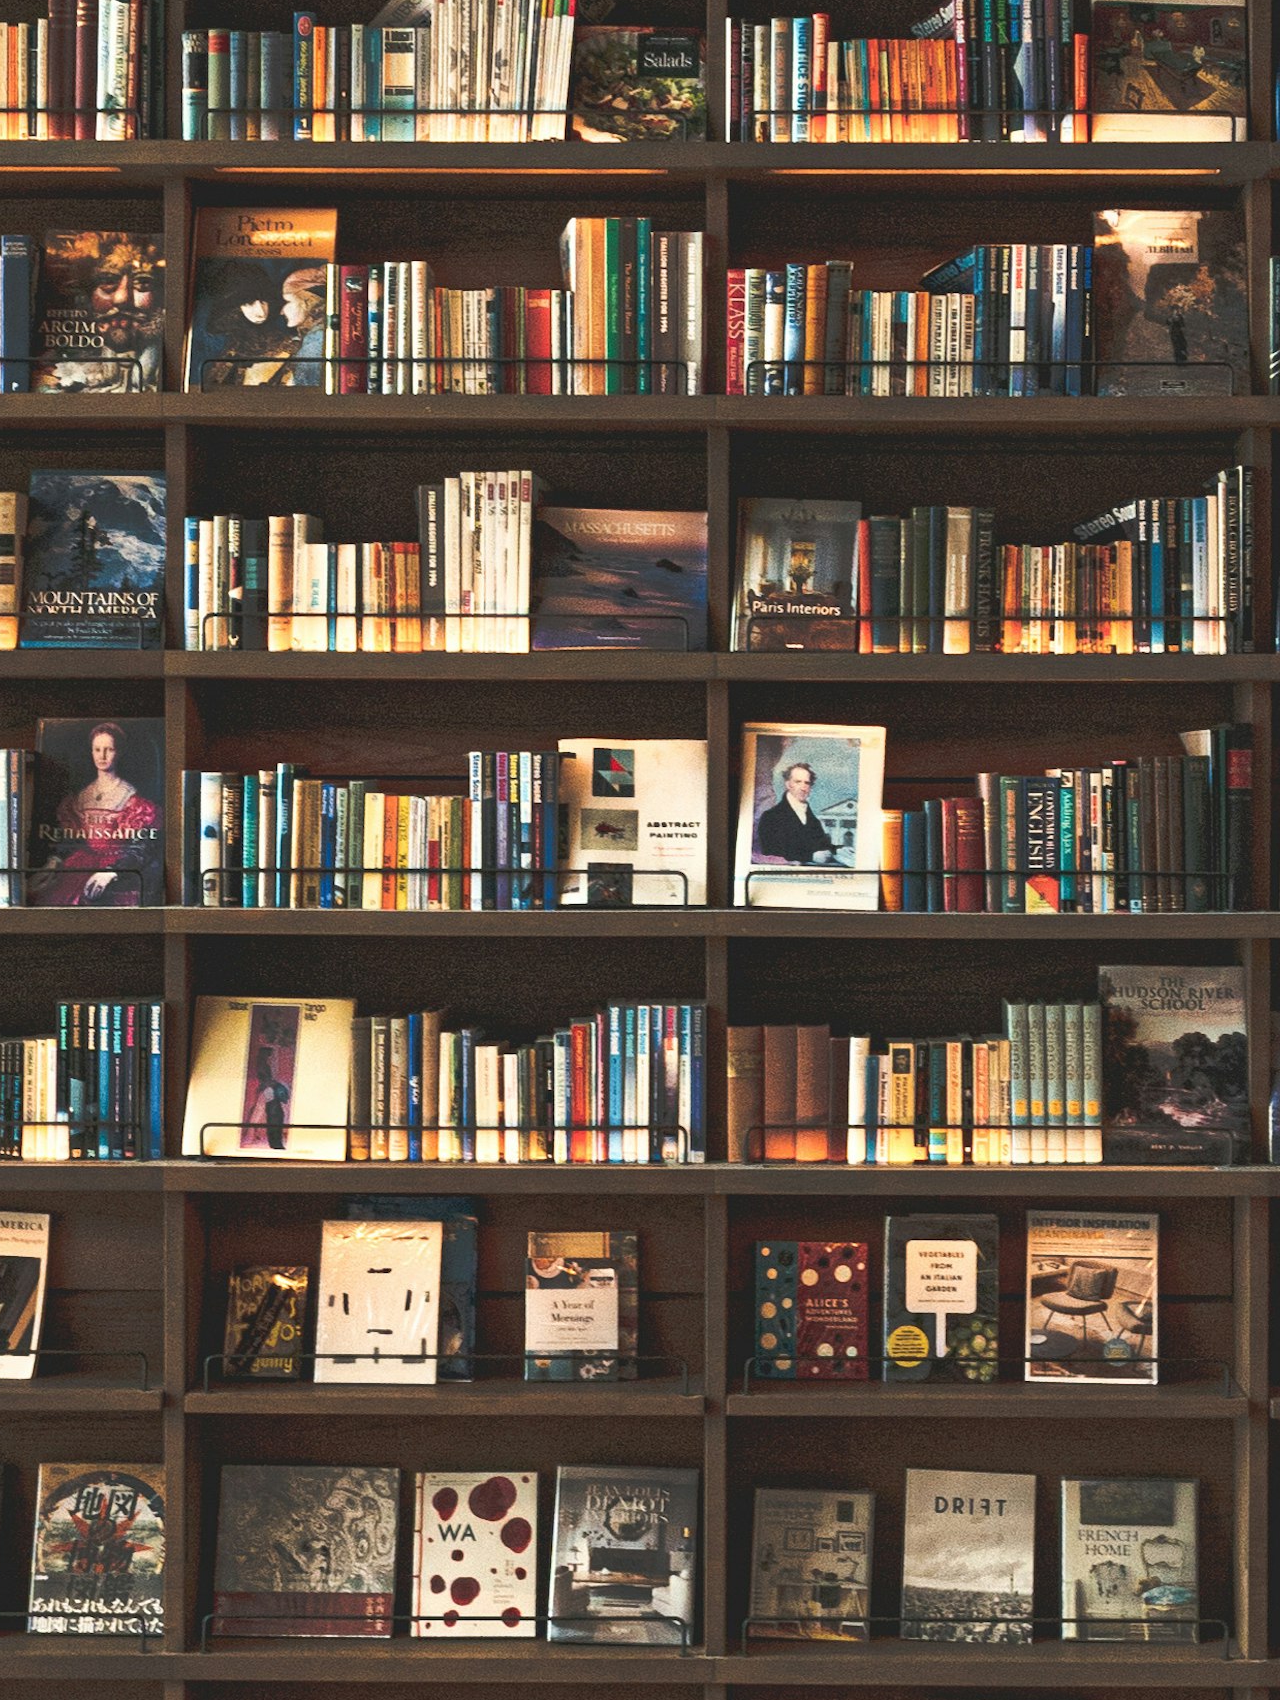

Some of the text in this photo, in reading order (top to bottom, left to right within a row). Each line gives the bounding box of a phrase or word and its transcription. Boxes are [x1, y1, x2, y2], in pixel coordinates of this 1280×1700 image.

[643, 51, 693, 68] Salads
[752, 601, 841, 617] Paris Interiors
[39, 824, 158, 842] RENAISSANCE
[437, 1523, 477, 1542] WA
[1078, 1529, 1139, 1542] FRENCH
[1085, 1543, 1132, 1556] HOME
